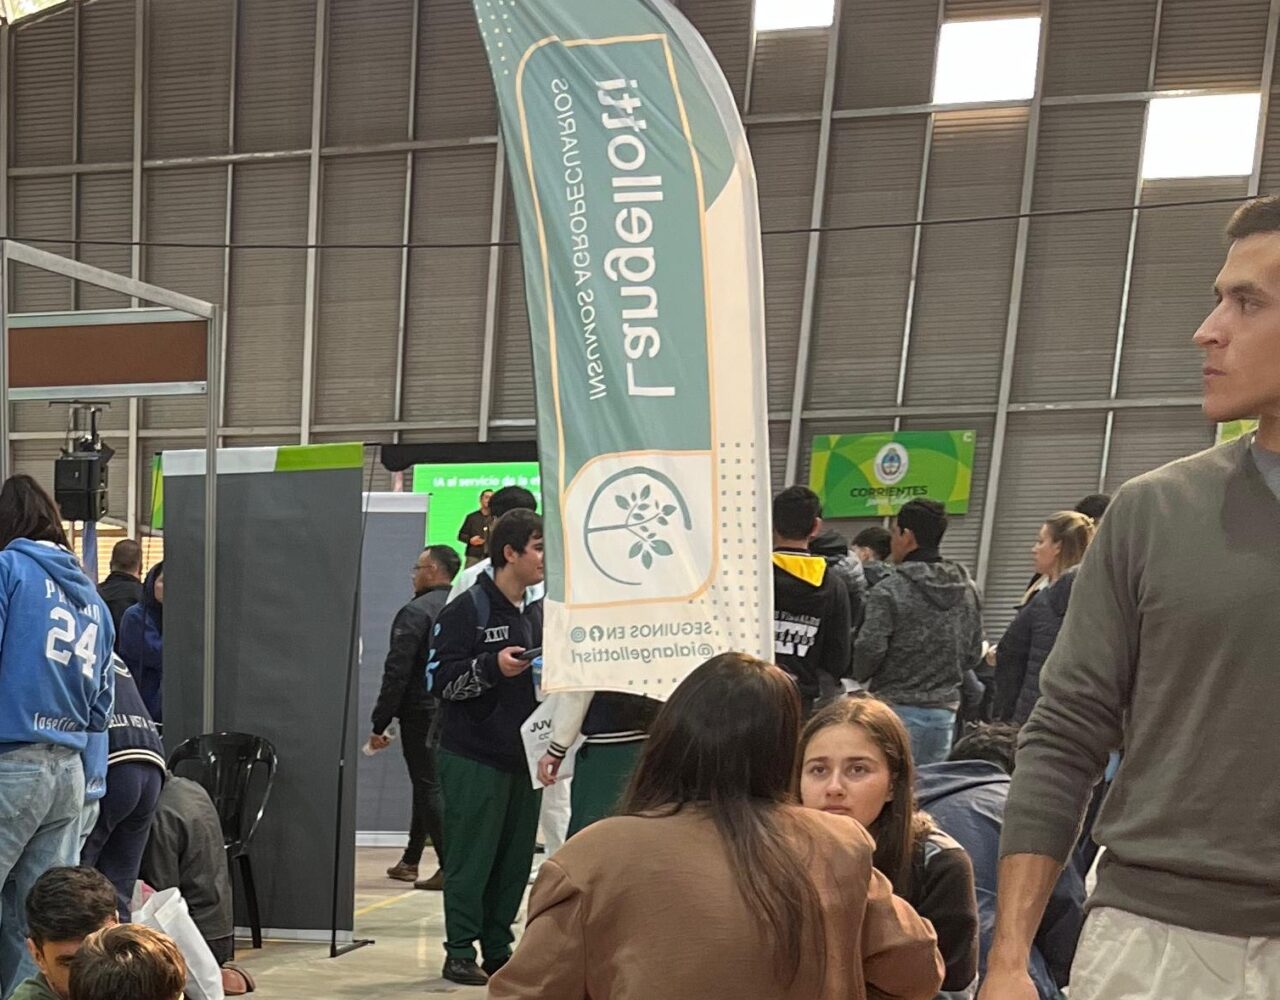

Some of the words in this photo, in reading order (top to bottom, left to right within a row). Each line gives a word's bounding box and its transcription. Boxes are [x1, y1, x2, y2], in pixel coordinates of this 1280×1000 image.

[459, 476, 500, 487] servicio
[502, 475, 516, 487] de
[850, 485, 928, 498] CORRIENTES
[483, 625, 510, 643] XXIV
[45, 606, 99, 679] 24
